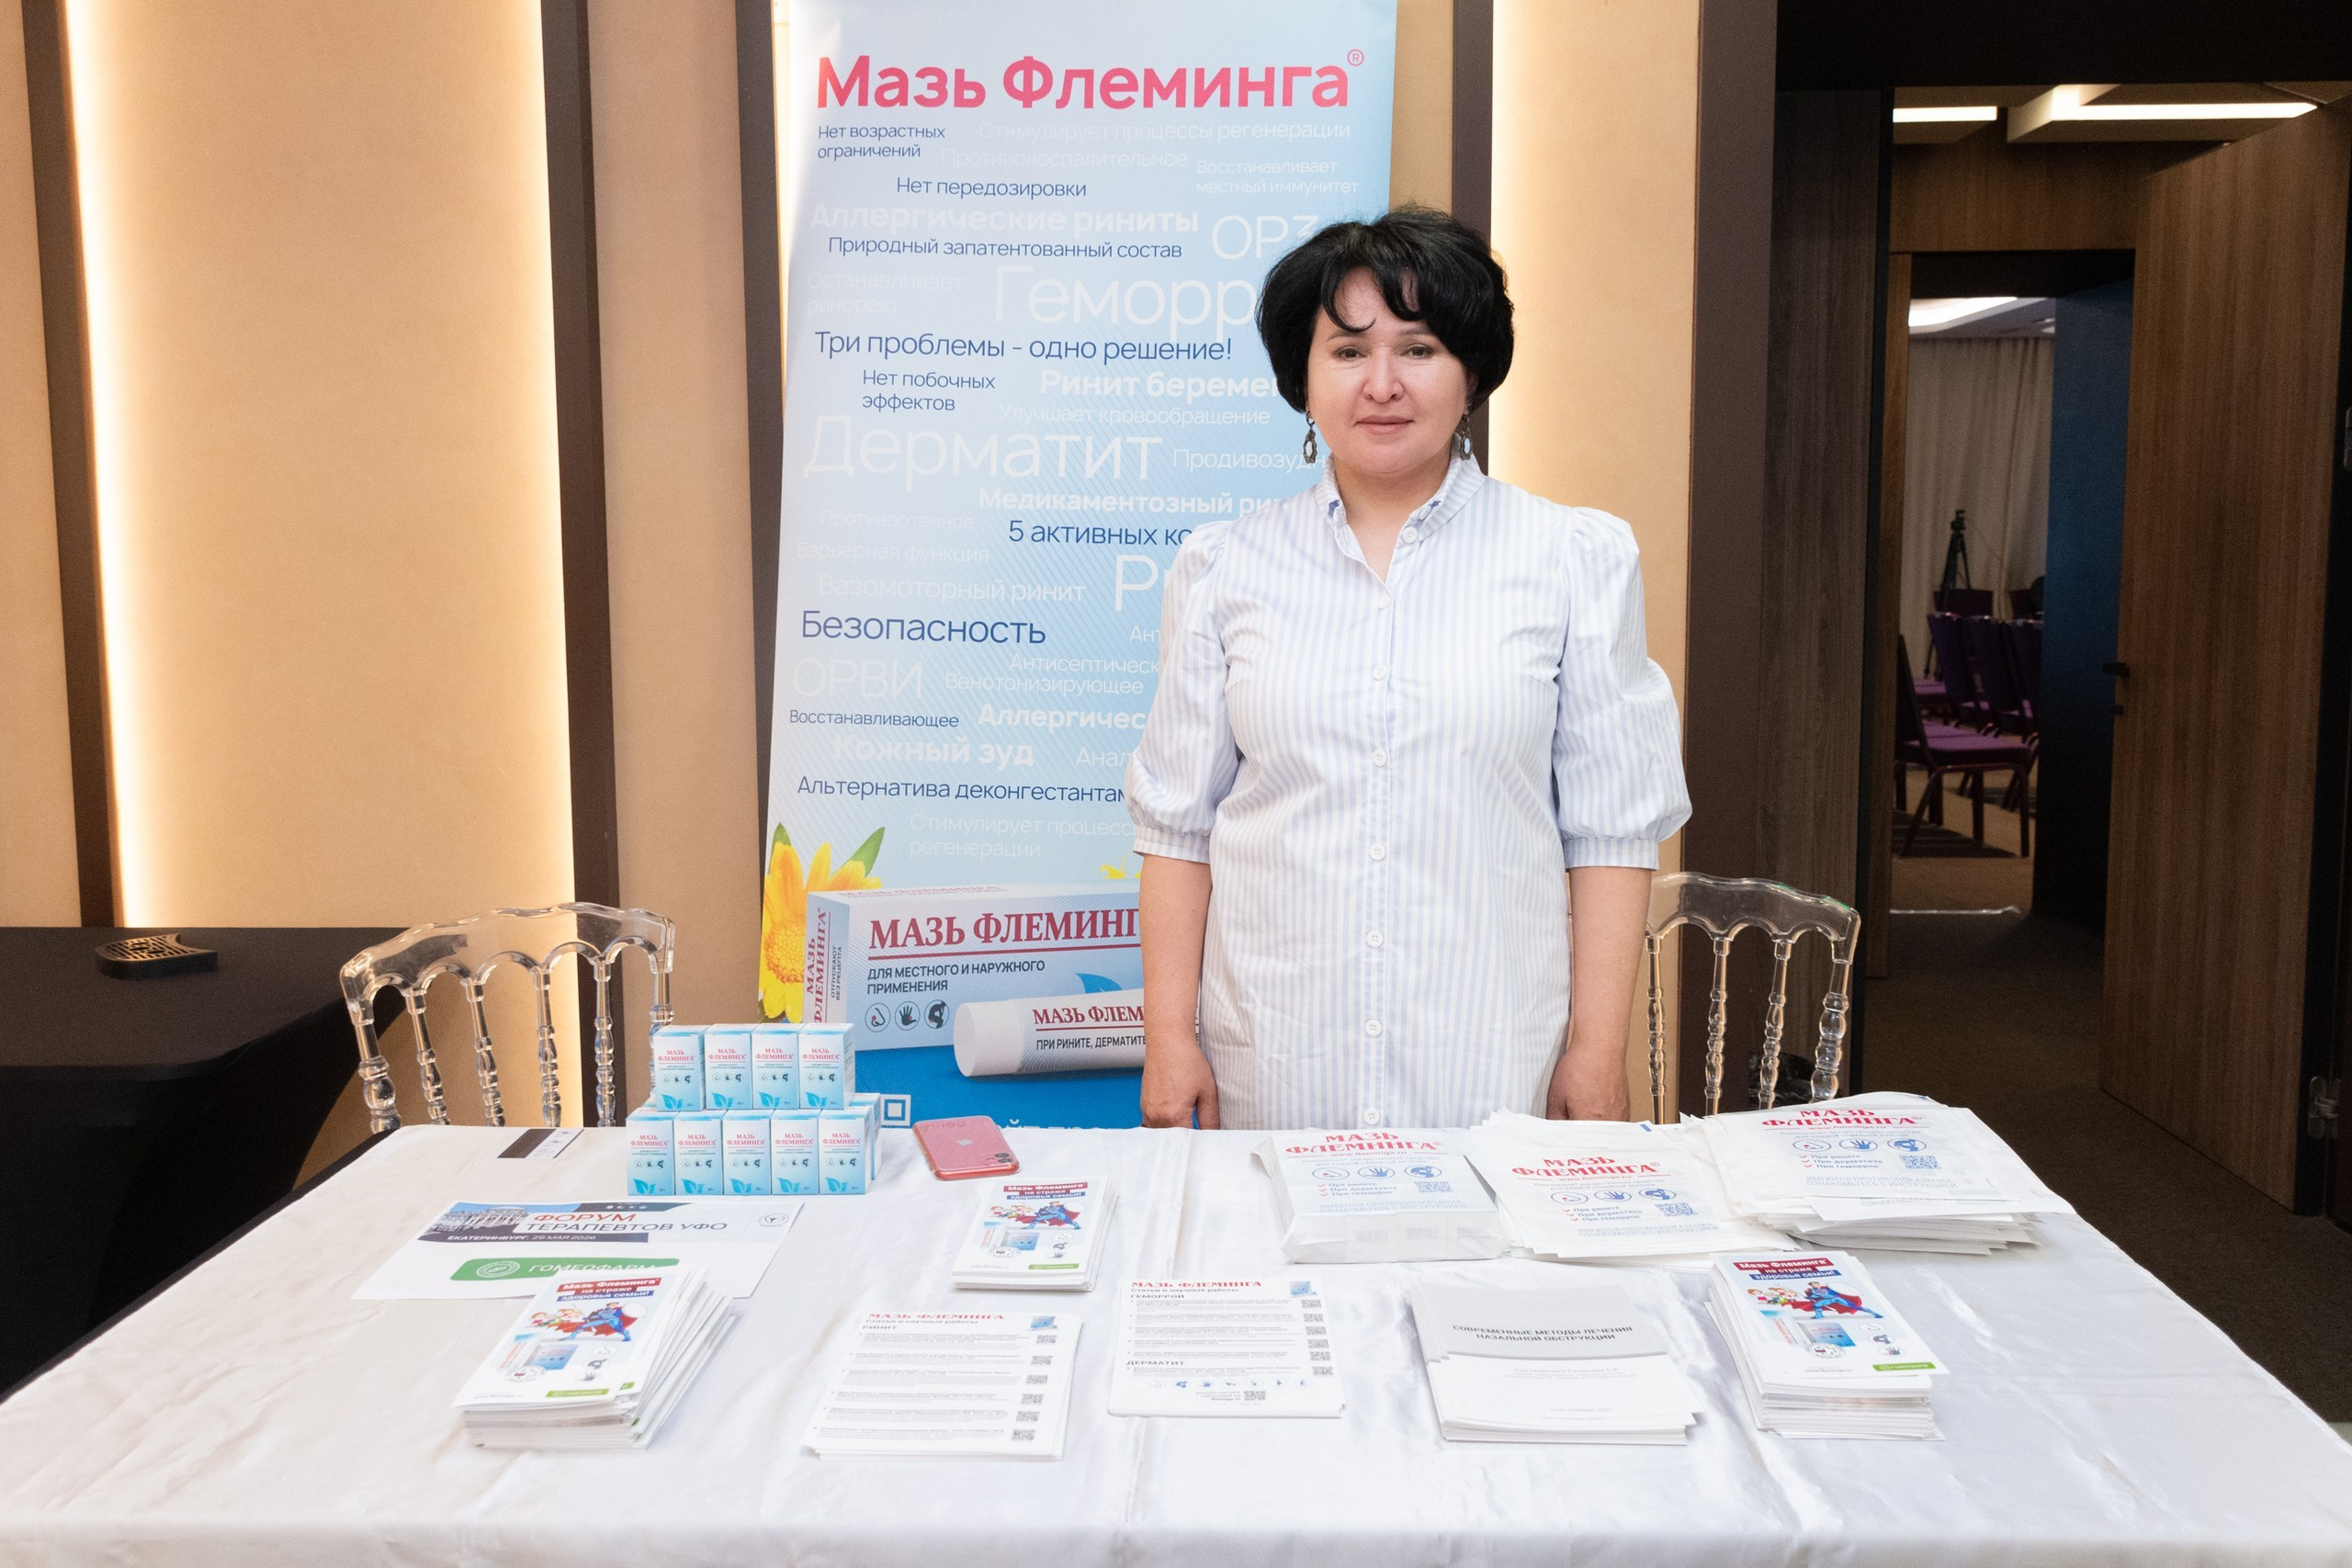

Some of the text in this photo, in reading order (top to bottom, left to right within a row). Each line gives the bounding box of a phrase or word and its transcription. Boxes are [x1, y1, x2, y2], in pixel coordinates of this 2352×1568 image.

[817, 55, 987, 109] Мазь
[818, 125, 946, 142] Нет возрастных
[978, 121, 1351, 144] Стимулирует процессы регенерации
[817, 144, 922, 163] ограничений
[941, 149, 1189, 171] Противовоспалительное
[1196, 160, 1339, 175] Восстанавливает
[896, 177, 1088, 201] Нет передозировки
[1196, 179, 1360, 198] местный иммунитет
[810, 204, 1199, 241] Аллергические риниты
[828, 236, 1182, 260] Природный запатентованный состав
[808, 271, 966, 292] Останавливает
[807, 296, 899, 316] ринорею
[994, 265, 1259, 344] Геморр
[815, 331, 861, 360] Три
[866, 333, 1005, 361] проблемы
[1028, 339, 1099, 361] одно
[1103, 337, 1233, 367] решение!
[863, 369, 997, 390] Нет побочных
[1041, 369, 1141, 399] Ринит
[862, 393, 956, 413] эффектов
[998, 404, 1272, 429] Улучшает кровообращение
[802, 415, 1164, 493] Дерматит
[978, 488, 1233, 514] Медикаментозный
[820, 510, 975, 531] Противоотечное
[1009, 519, 1026, 544] 5
[1030, 524, 1160, 547] активных
[797, 540, 989, 566] Барьерная функция
[818, 574, 1088, 607] Вазомоторный ринит
[800, 609, 1047, 646] Безопасность
[1009, 654, 1161, 676] Антисептическ
[793, 658, 923, 700] ОРВИ
[944, 671, 1145, 697] Венотонизирующее
[788, 708, 961, 728] Восстанавливающее
[977, 703, 1148, 735] Аллергичес
[832, 733, 1035, 773] Кожный зуд
[797, 775, 951, 801] Альтернатива
[909, 812, 1045, 839] Стимулирует
[908, 838, 1042, 861] регенерации
[868, 907, 1141, 951] МАЗЬ ФЛЕМИНГ
[806, 937, 818, 995] МАЗЬ
[830, 944, 838, 999] ОТПУСКАЮТ
[866, 959, 1046, 981] ДЛЯ МЕСТНОГО И НАРУЖНОГО
[866, 979, 949, 995] ПРИМЕНЕНИЯ
[1032, 1005, 1145, 1025] МАЗЬ ФЛЕМ
[1035, 1038, 1056, 1051] ПРИ
[1057, 1037, 1094, 1051] РИНИТЕ,
[1799, 1109, 1876, 1119] МАЗЬ
[1325, 1132, 1400, 1144] МАЗЬ
[1543, 1156, 1615, 1168] МАЗЬ
[526, 1222, 729, 1233] ТЕРАПЕВТОВ УФО
[534, 1213, 638, 1223] ФОРУМ
[1737, 1261, 1770, 1270] Мазь
[561, 1292, 610, 1302] здоровья
[562, 1282, 594, 1292] Мазь
[599, 1286, 634, 1294] страже
[1452, 1324, 1533, 1337] СОВРЕМЕННЫЕ
[1582, 1325, 1634, 1335] ЛЕЧЕНИЯ
[1476, 1332, 1616, 1343] НАЗАЛЬНОЙ ОБСТРУКЦИИ
